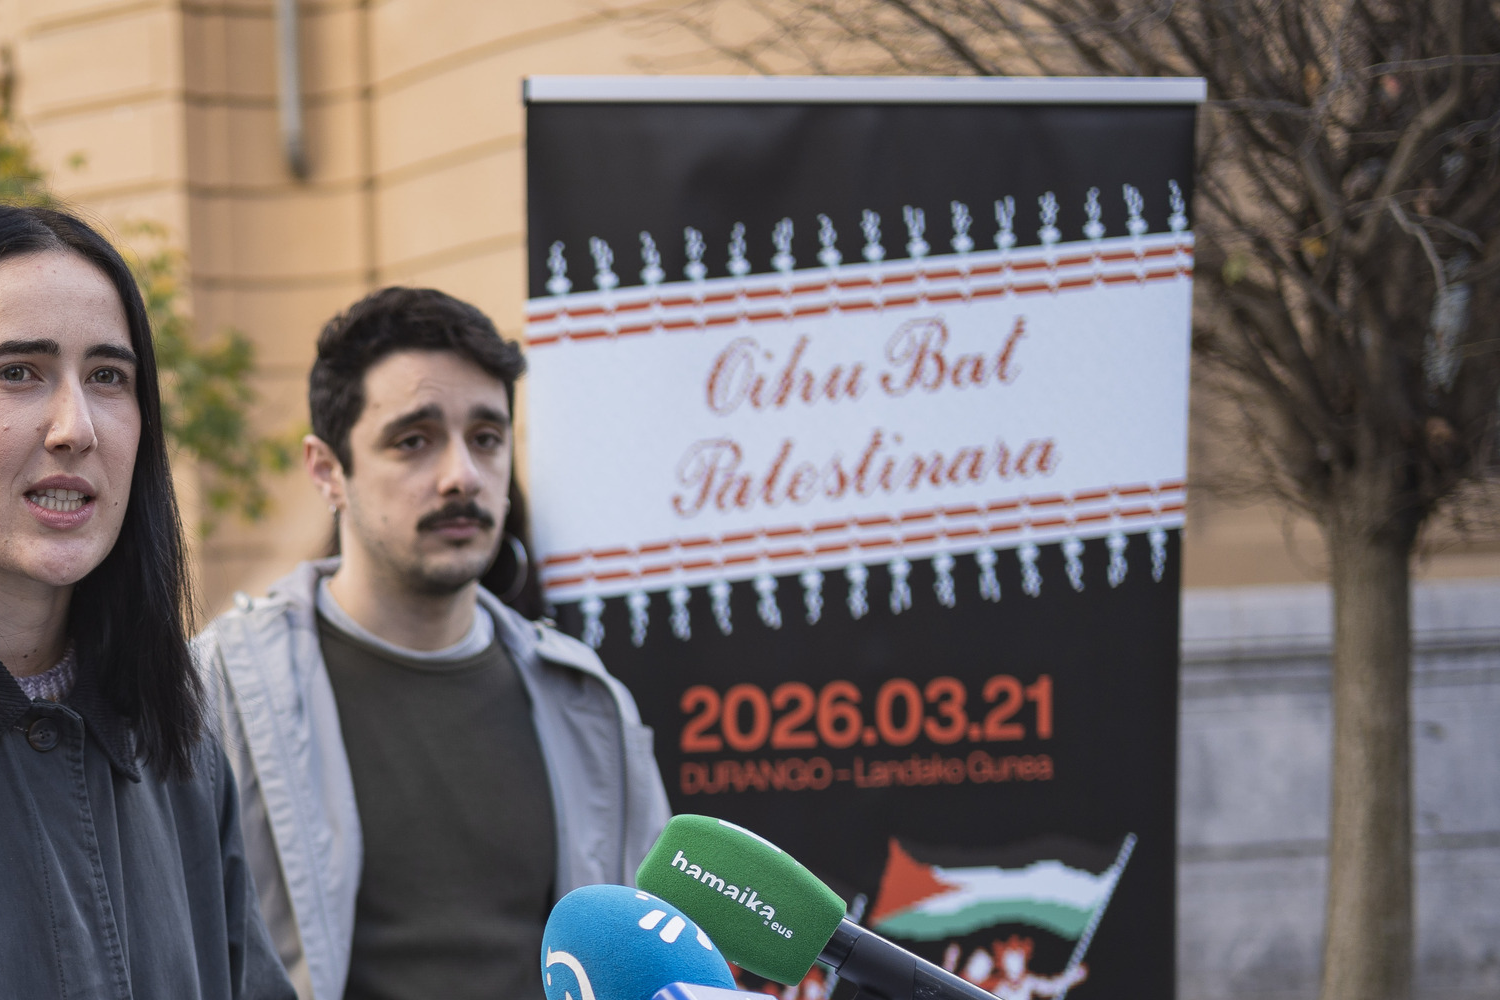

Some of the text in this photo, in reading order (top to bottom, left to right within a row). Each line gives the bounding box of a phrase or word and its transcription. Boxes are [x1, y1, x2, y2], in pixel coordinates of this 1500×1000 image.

[705, 315, 1027, 416] Oihu Bat
[670, 427, 1060, 518] Palestinara
[680, 674, 1054, 753] 2026.03.21
[680, 756, 833, 795] DURANGO
[853, 752, 966, 788] Landako
[966, 750, 1055, 784] Gunea
